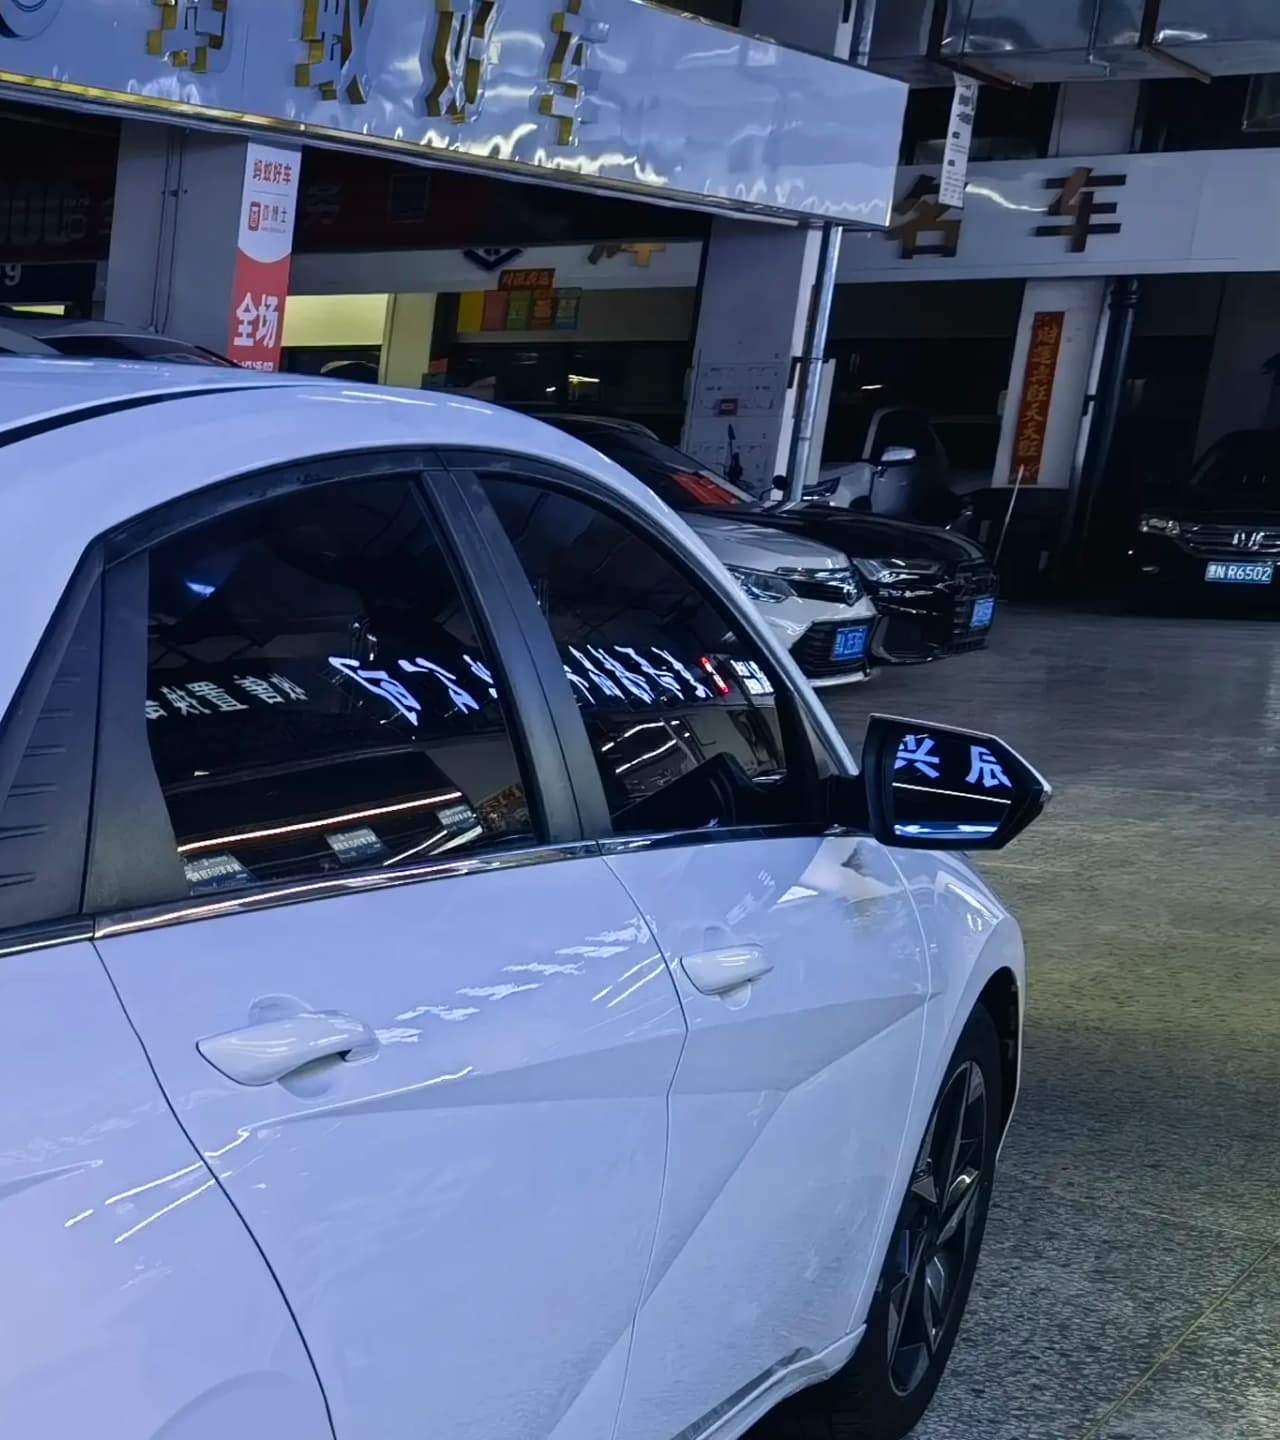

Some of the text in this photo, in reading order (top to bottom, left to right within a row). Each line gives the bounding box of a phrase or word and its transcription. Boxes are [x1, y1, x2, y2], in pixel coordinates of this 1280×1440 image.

[252, 159, 292, 185] 蚂蚁好车
[233, 292, 279, 348] 全场
